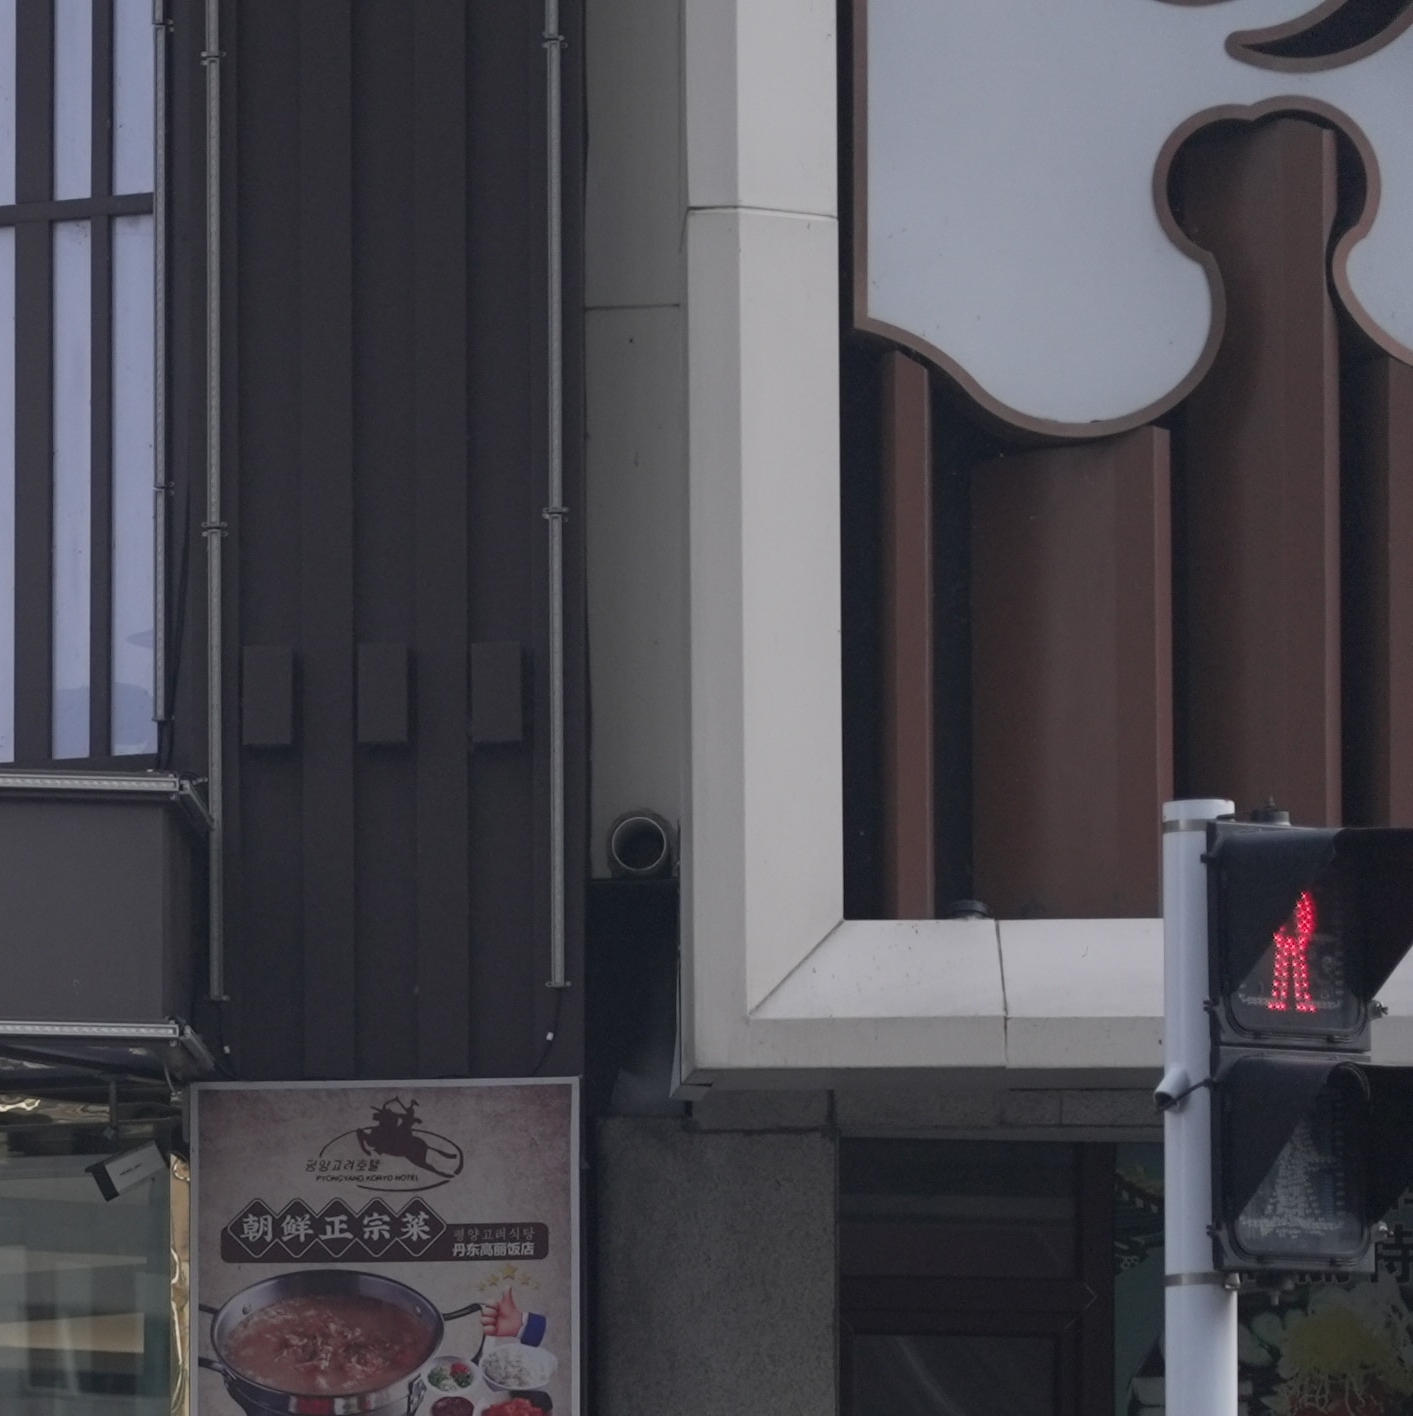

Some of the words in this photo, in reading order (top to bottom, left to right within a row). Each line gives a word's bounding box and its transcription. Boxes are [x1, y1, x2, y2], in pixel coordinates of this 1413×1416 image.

[395, 1173, 420, 1181] HOTEL
[240, 1211, 432, 1242] 朝鲜正宗菜
[453, 1226, 536, 1242] 평양고려식당
[452, 1242, 535, 1257] 丹东高丽饭店
